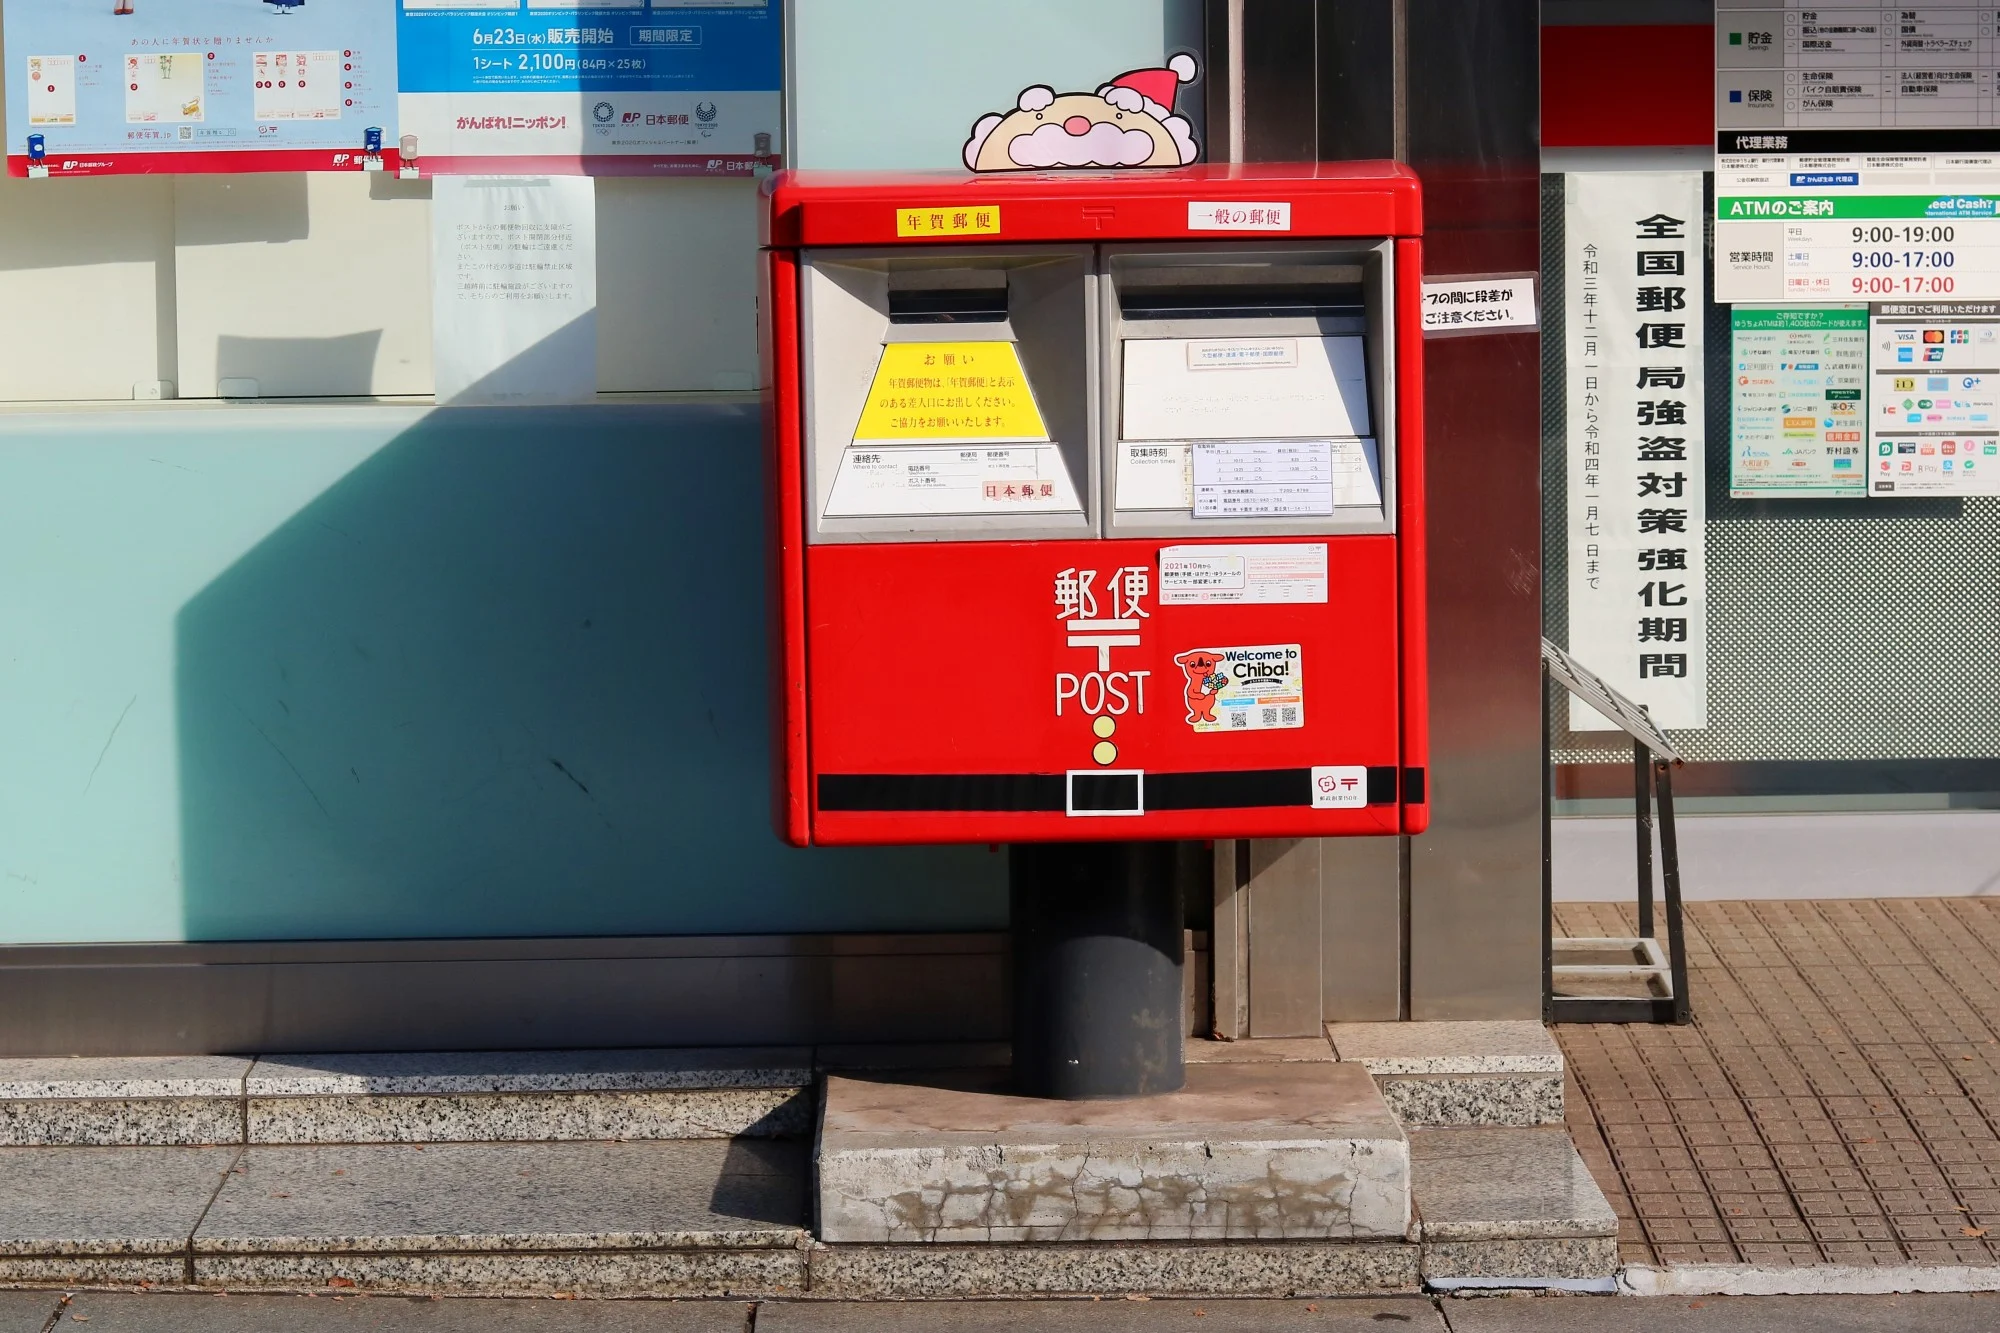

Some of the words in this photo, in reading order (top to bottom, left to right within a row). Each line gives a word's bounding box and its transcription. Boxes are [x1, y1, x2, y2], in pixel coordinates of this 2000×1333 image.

[1802, 12, 1817, 20] 貯金
[131, 36, 274, 47] あの人に年賀状を贈りませんか
[638, 29, 693, 42] 期間限定
[1748, 32, 1772, 44] 貯金
[473, 56, 513, 70] 1シート
[1802, 72, 1833, 80] 生命保険
[1748, 90, 1772, 102] 保険
[646, 114, 689, 125] 日本郵便
[127, 130, 172, 140] 郵便年賀.jp
[1736, 136, 1788, 149] 代理業務
[1730, 200, 1834, 216] ATMのご案内
[1928, 198, 1954, 209] eed
[1956, 198, 1993, 209] Cash?
[906, 212, 991, 230] 年賀郵便
[1198, 208, 1281, 225] 一般の郵便
[1852, 226, 1954, 243] 9:00-19:00
[1729, 252, 1774, 263] 営業時間
[1852, 251, 1954, 268] 9:00-17:00
[1852, 276, 1954, 293] 9:00-17:00
[1881, 305, 1996, 314] 郵便窓口でご利用いただけます
[1425, 309, 1514, 324] ご注意ください。
[924, 353, 975, 366] お願い
[890, 416, 1007, 428] ご協力をお願いいたします。
[1583, 243, 1600, 590] 令和三年十二月一日から令和四年一月七日まで
[1130, 448, 1168, 458] 取集時刻
[1636, 214, 1688, 679] 全国郵便局強盗対策強化期間
[852, 454, 881, 464] 連絡先
[986, 484, 1053, 497] 日本郵便
[1054, 566, 1150, 620] 郵便
[1225, 650, 1283, 662] Welcome
[1285, 648, 1297, 659] to
[1233, 661, 1289, 678] Chiba!
[1056, 670, 1151, 716] POST
